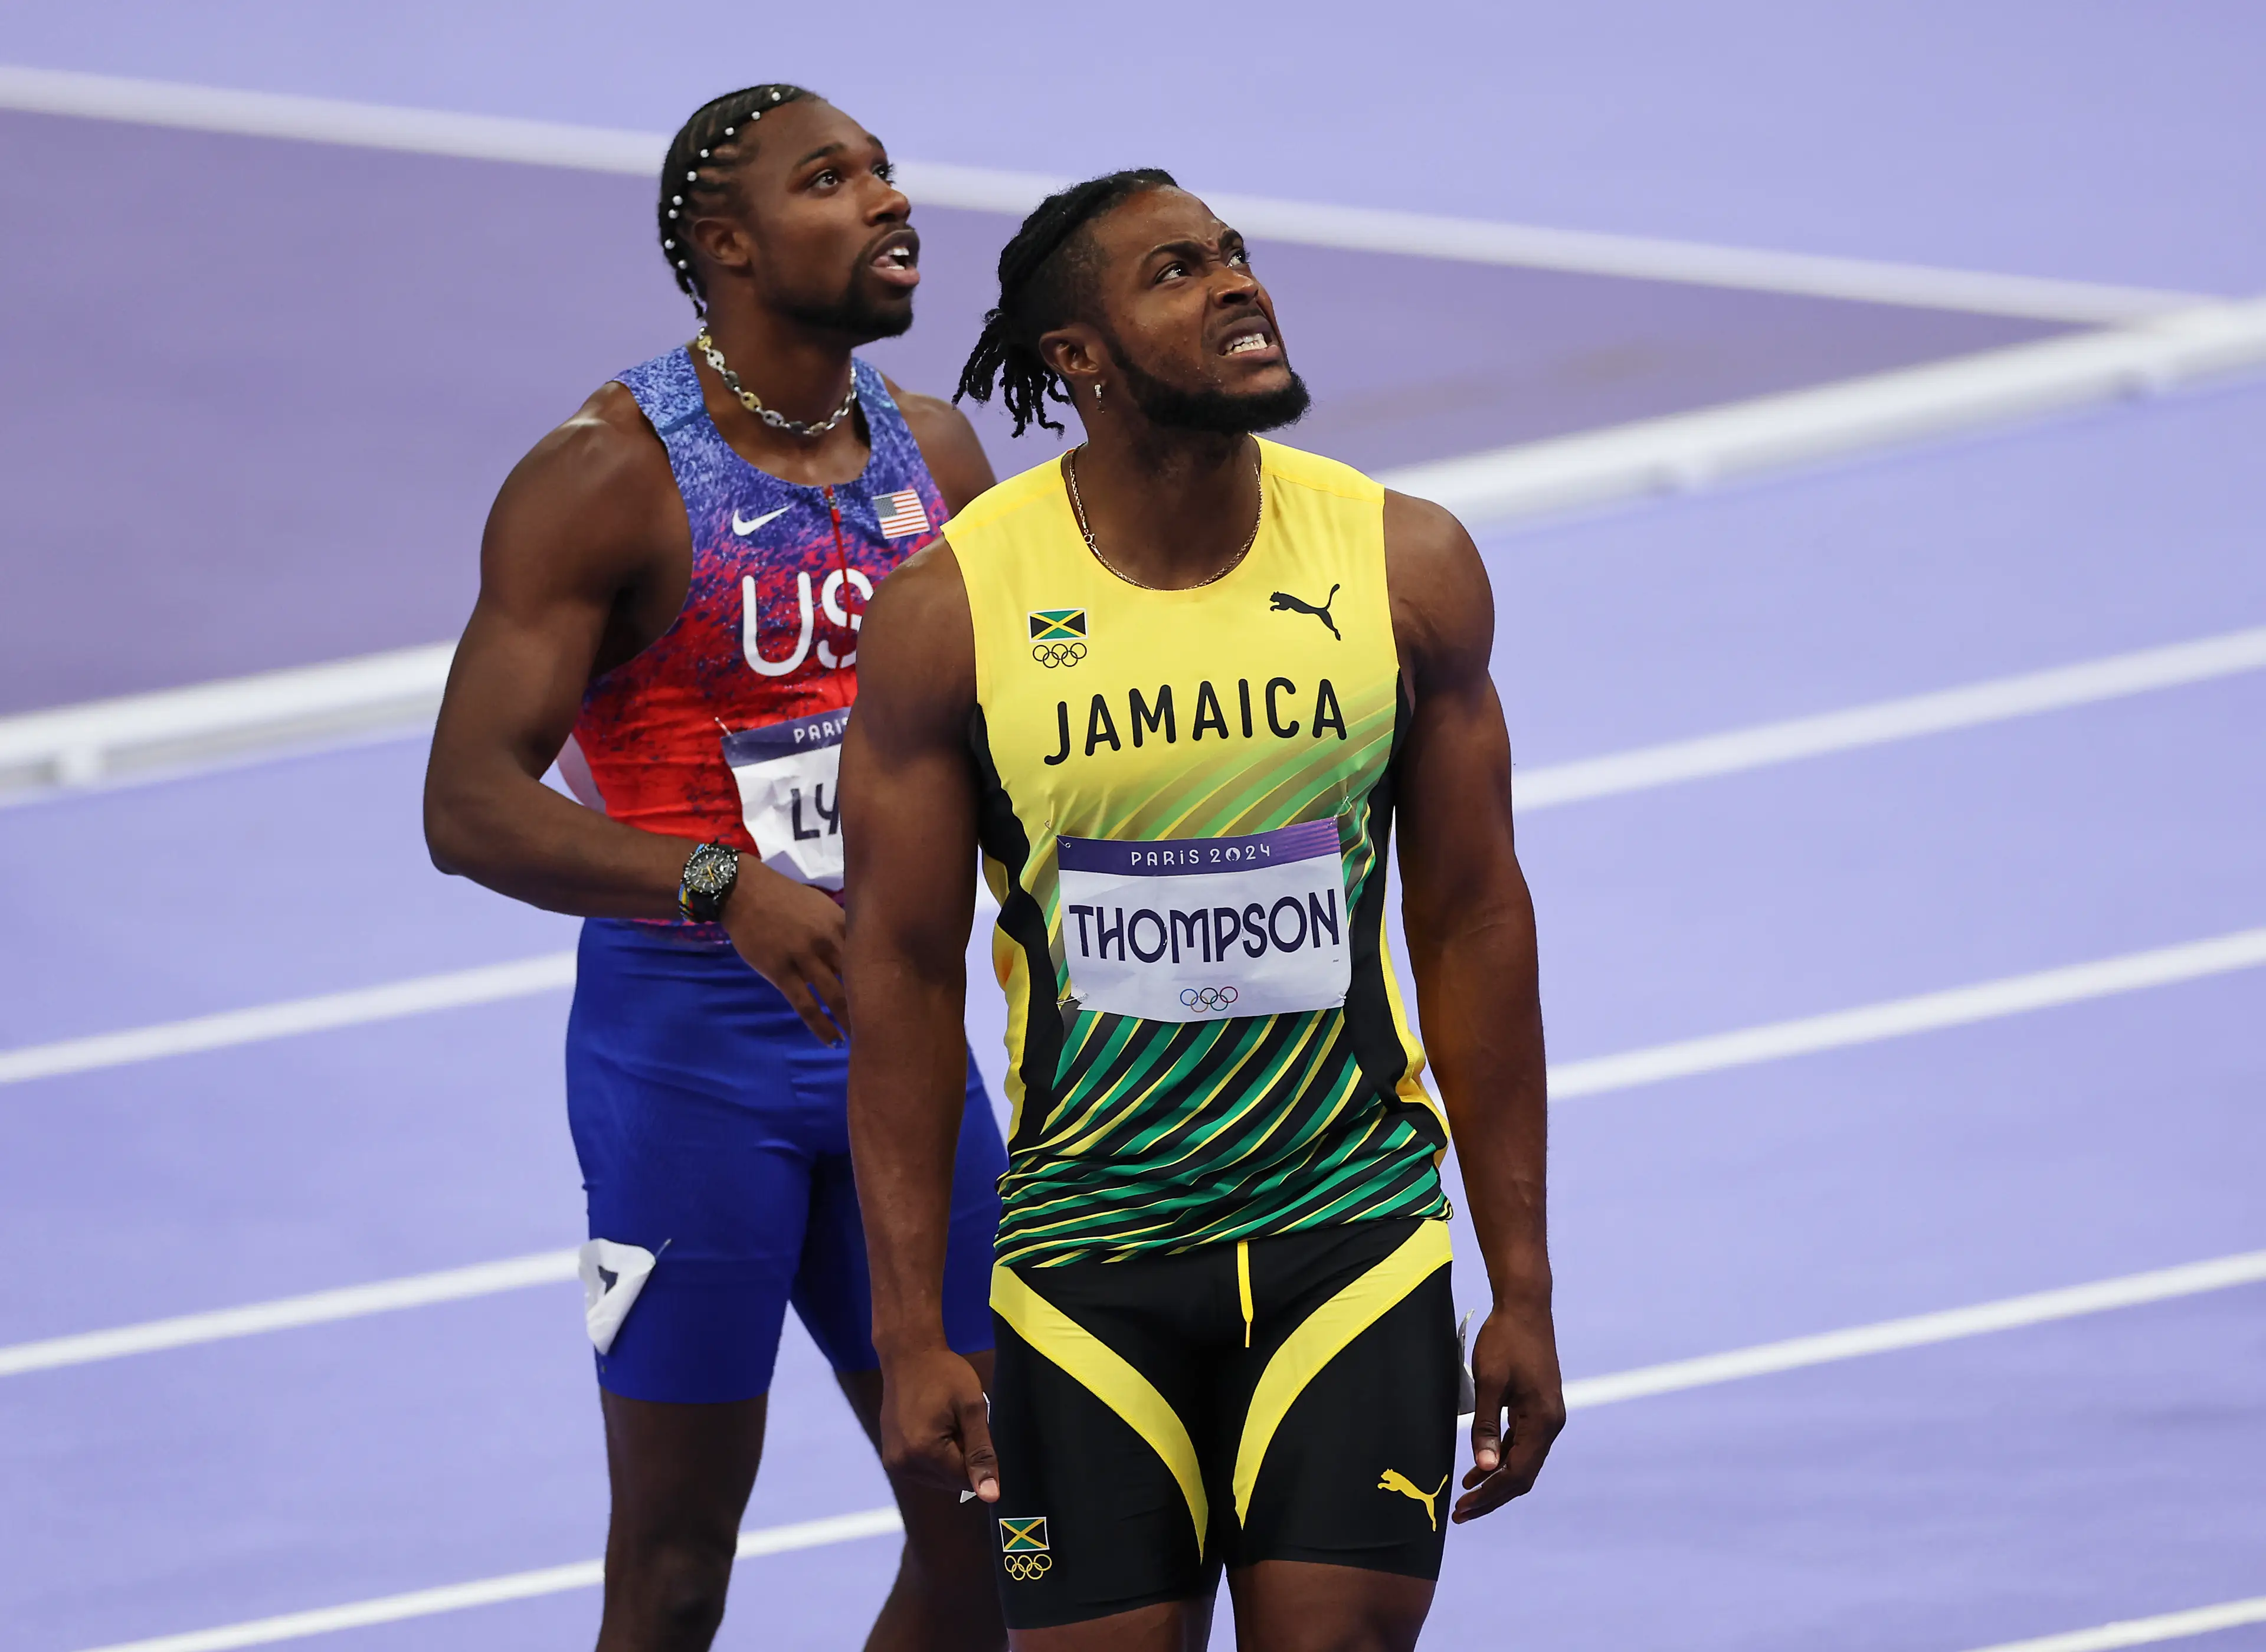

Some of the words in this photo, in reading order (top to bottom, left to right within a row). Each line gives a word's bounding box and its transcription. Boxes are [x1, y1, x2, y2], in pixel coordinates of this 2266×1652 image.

[1044, 677, 1347, 766] JAMAICA
[1210, 843, 1270, 863] 2024
[1069, 889, 1340, 964] THOMPSON
